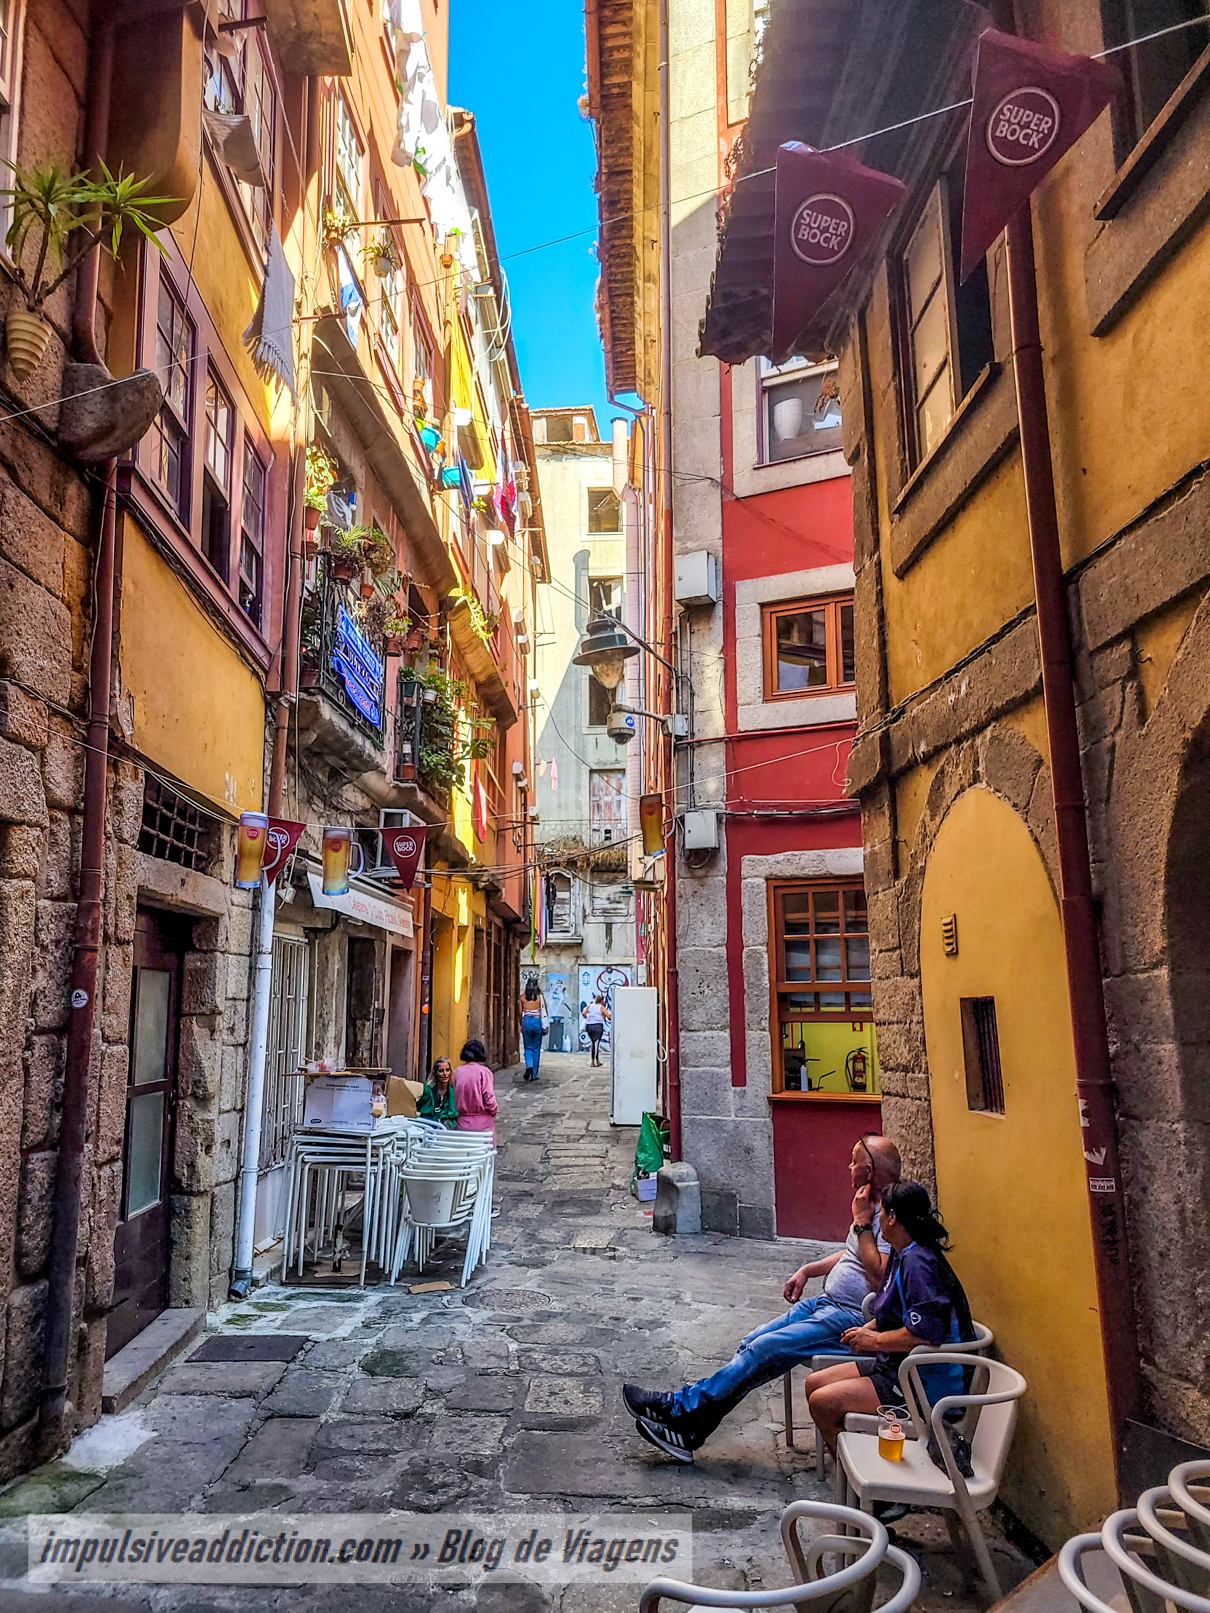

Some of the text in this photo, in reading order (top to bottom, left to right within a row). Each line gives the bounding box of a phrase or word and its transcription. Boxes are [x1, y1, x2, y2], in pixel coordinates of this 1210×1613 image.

[999, 103, 1053, 135] SUPER
[995, 121, 1044, 149] BOCK
[799, 209, 848, 237] SUPER
[797, 226, 842, 251] BOCK
[268, 835, 286, 845] BOK
